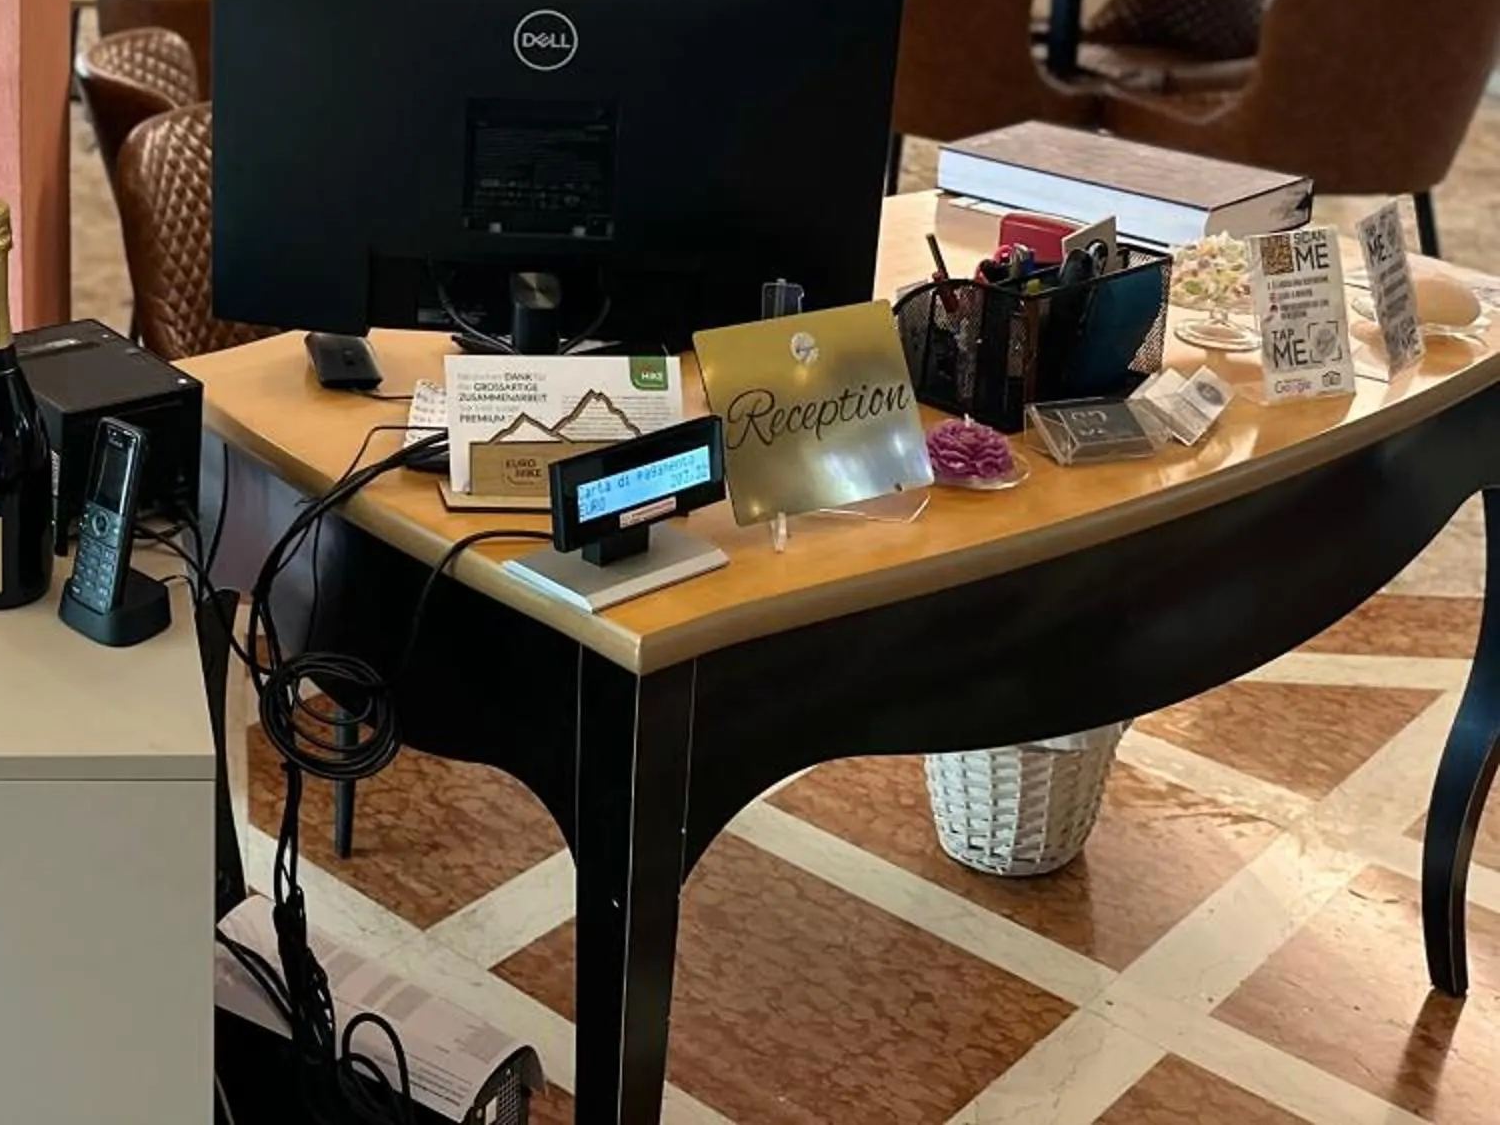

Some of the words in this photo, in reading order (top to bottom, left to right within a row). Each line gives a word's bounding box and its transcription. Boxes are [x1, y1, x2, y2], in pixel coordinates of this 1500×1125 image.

[521, 31, 572, 49] DELL
[1293, 229, 1327, 246] SCAN
[1294, 243, 1331, 272] ME
[1271, 328, 1295, 340] TAP
[1272, 338, 1309, 369] ME
[504, 372, 533, 382] DANK
[459, 413, 506, 424] PREMIUM
[726, 383, 910, 450] Reception
[504, 458, 538, 469] EURO
